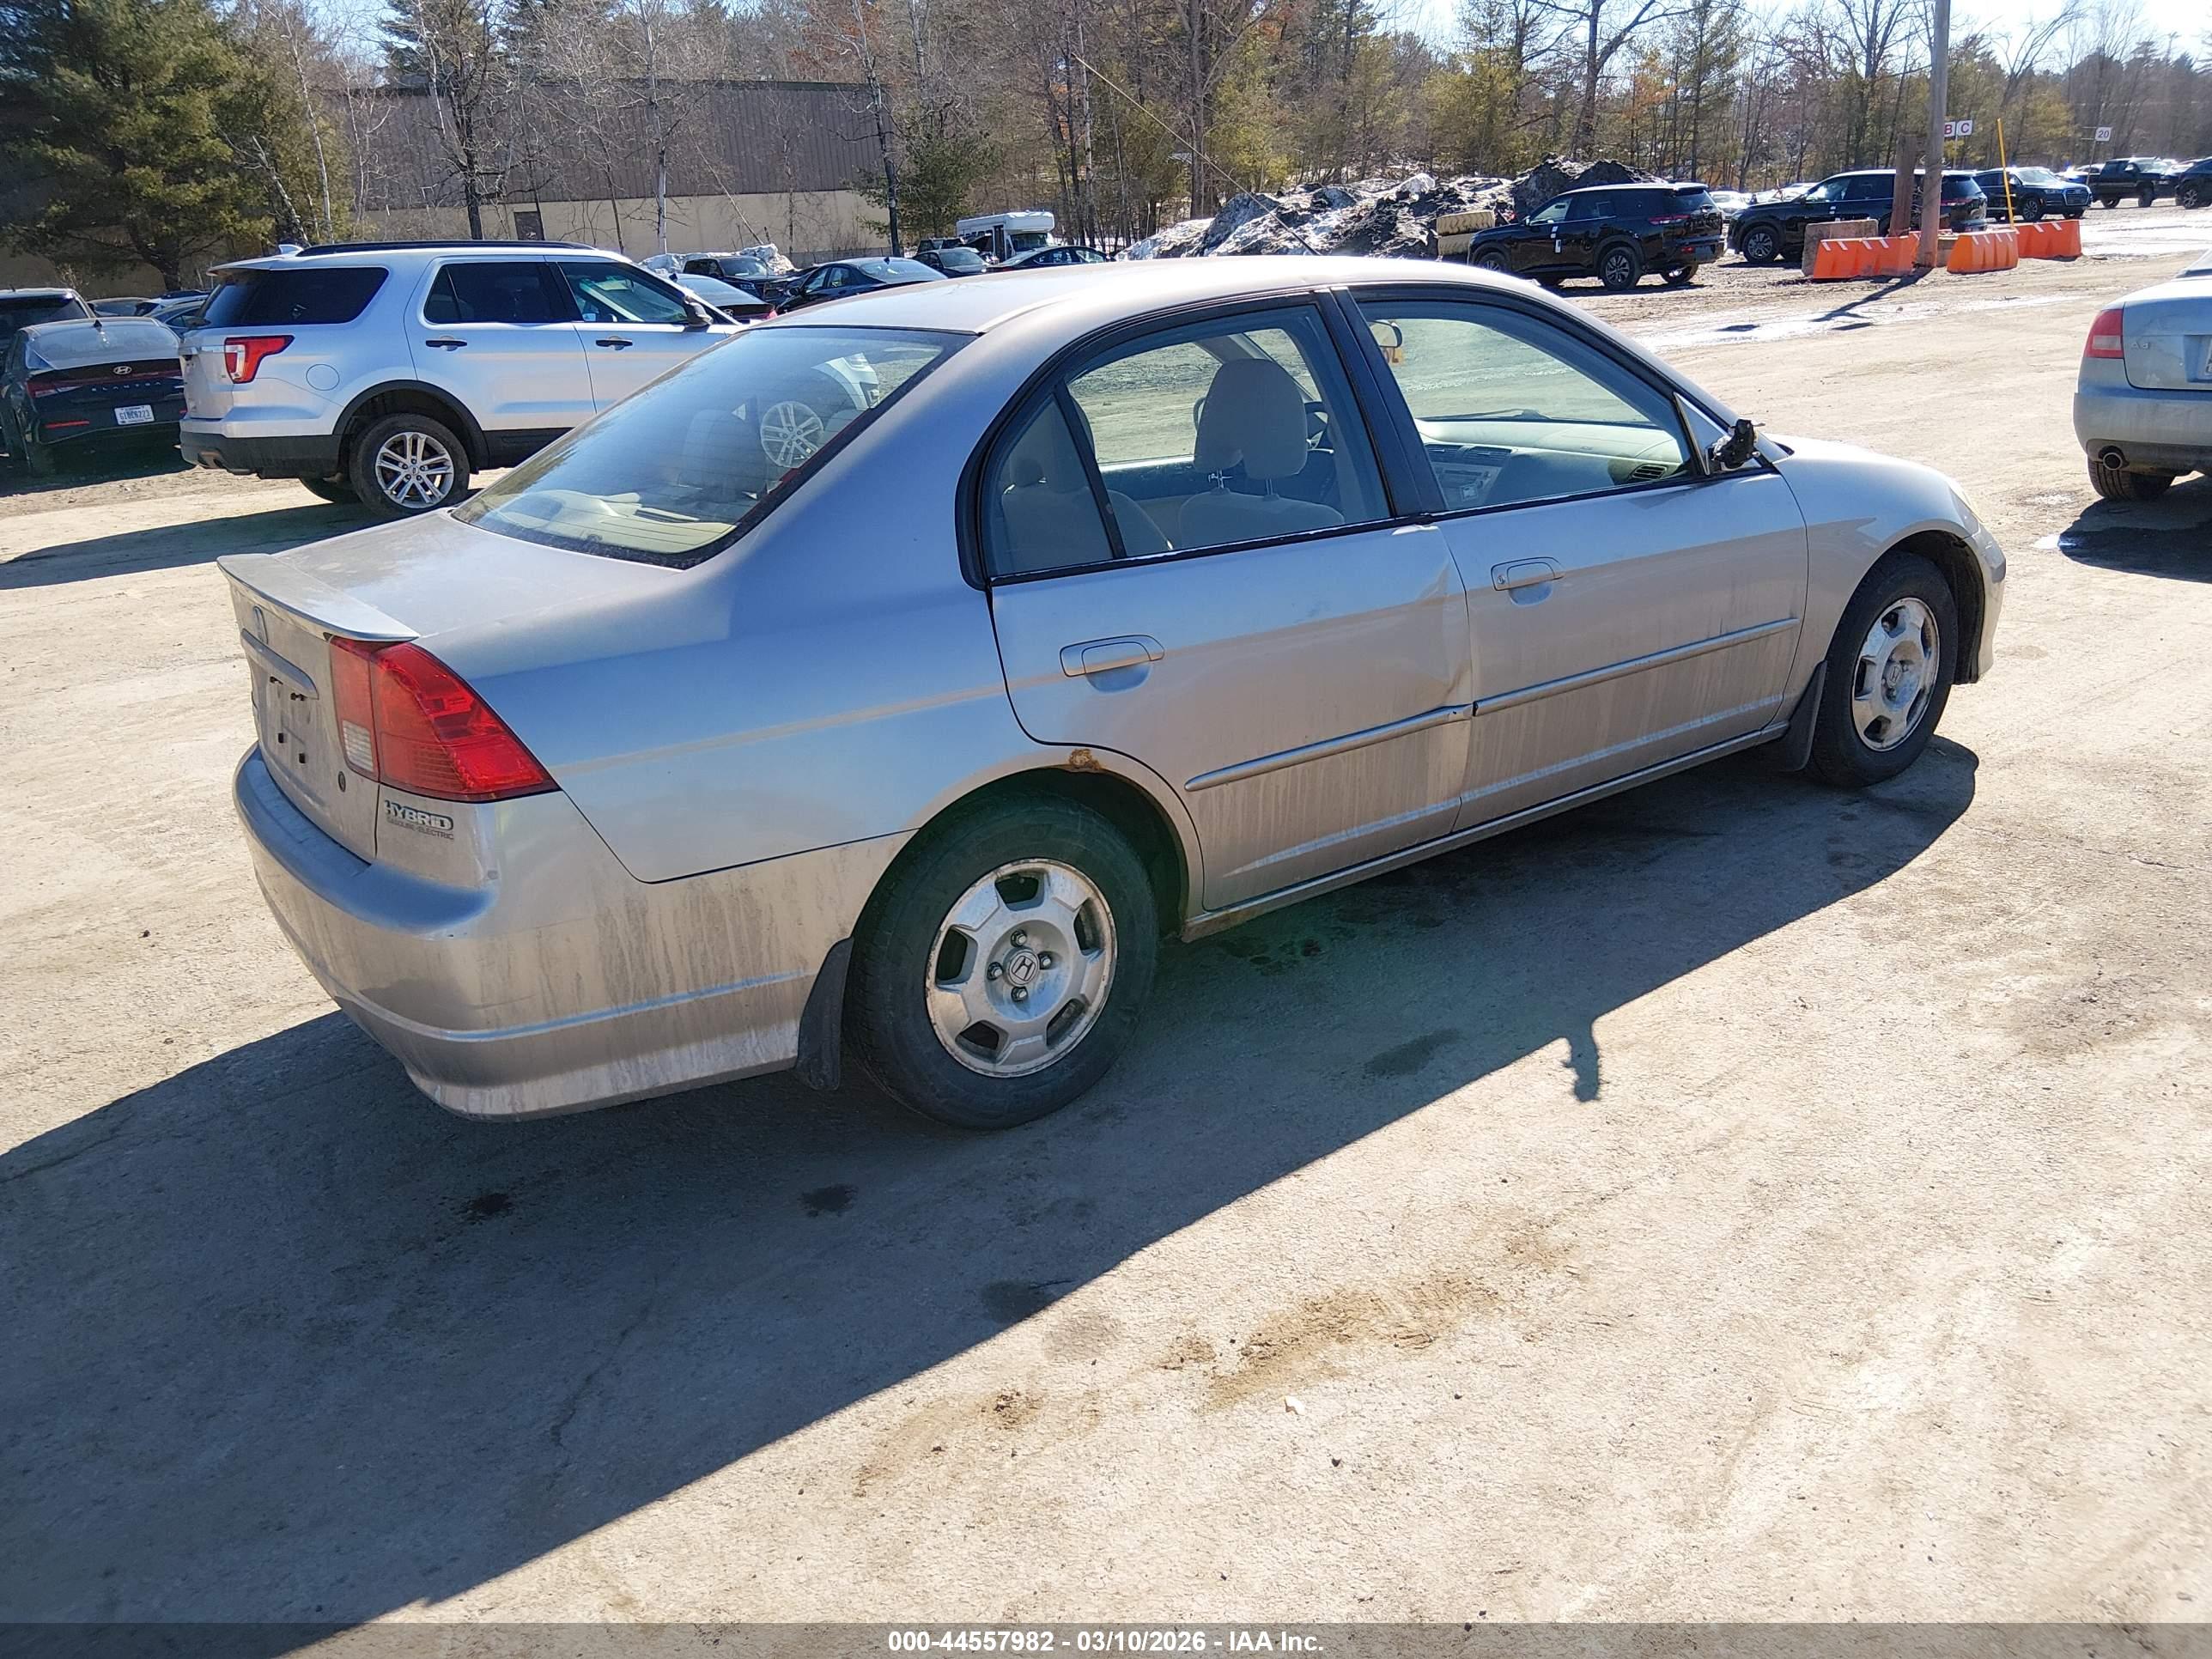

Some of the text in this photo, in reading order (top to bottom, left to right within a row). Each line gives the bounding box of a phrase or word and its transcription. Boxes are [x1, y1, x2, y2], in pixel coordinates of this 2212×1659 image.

[1944, 124, 1953, 135] B
[1960, 122, 1970, 133] C
[2097, 130, 2110, 138] 20
[385, 799, 454, 830] HYBRID
